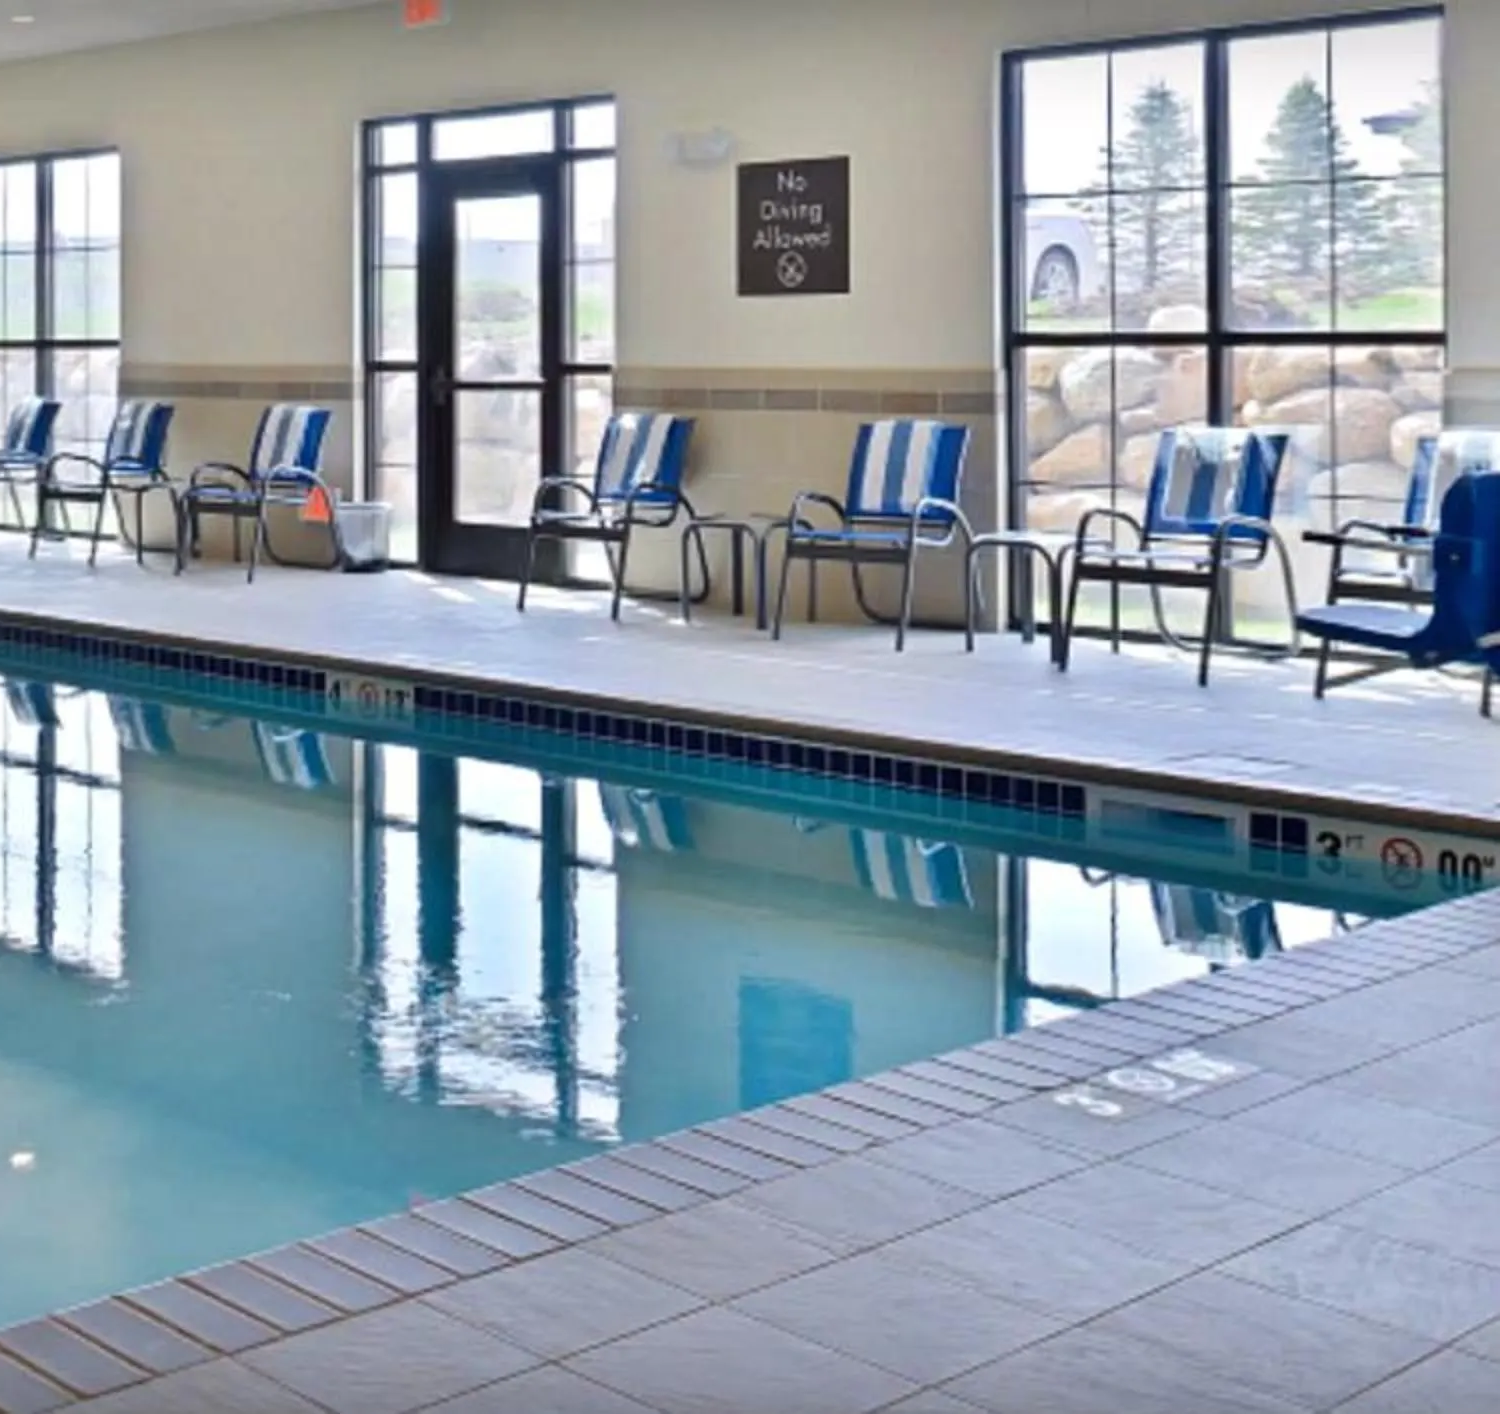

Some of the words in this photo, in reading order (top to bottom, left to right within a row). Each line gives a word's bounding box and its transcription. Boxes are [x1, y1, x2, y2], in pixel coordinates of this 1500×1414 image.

[776, 169, 808, 192] No
[760, 198, 824, 224] Diving
[753, 223, 832, 250] Allowed
